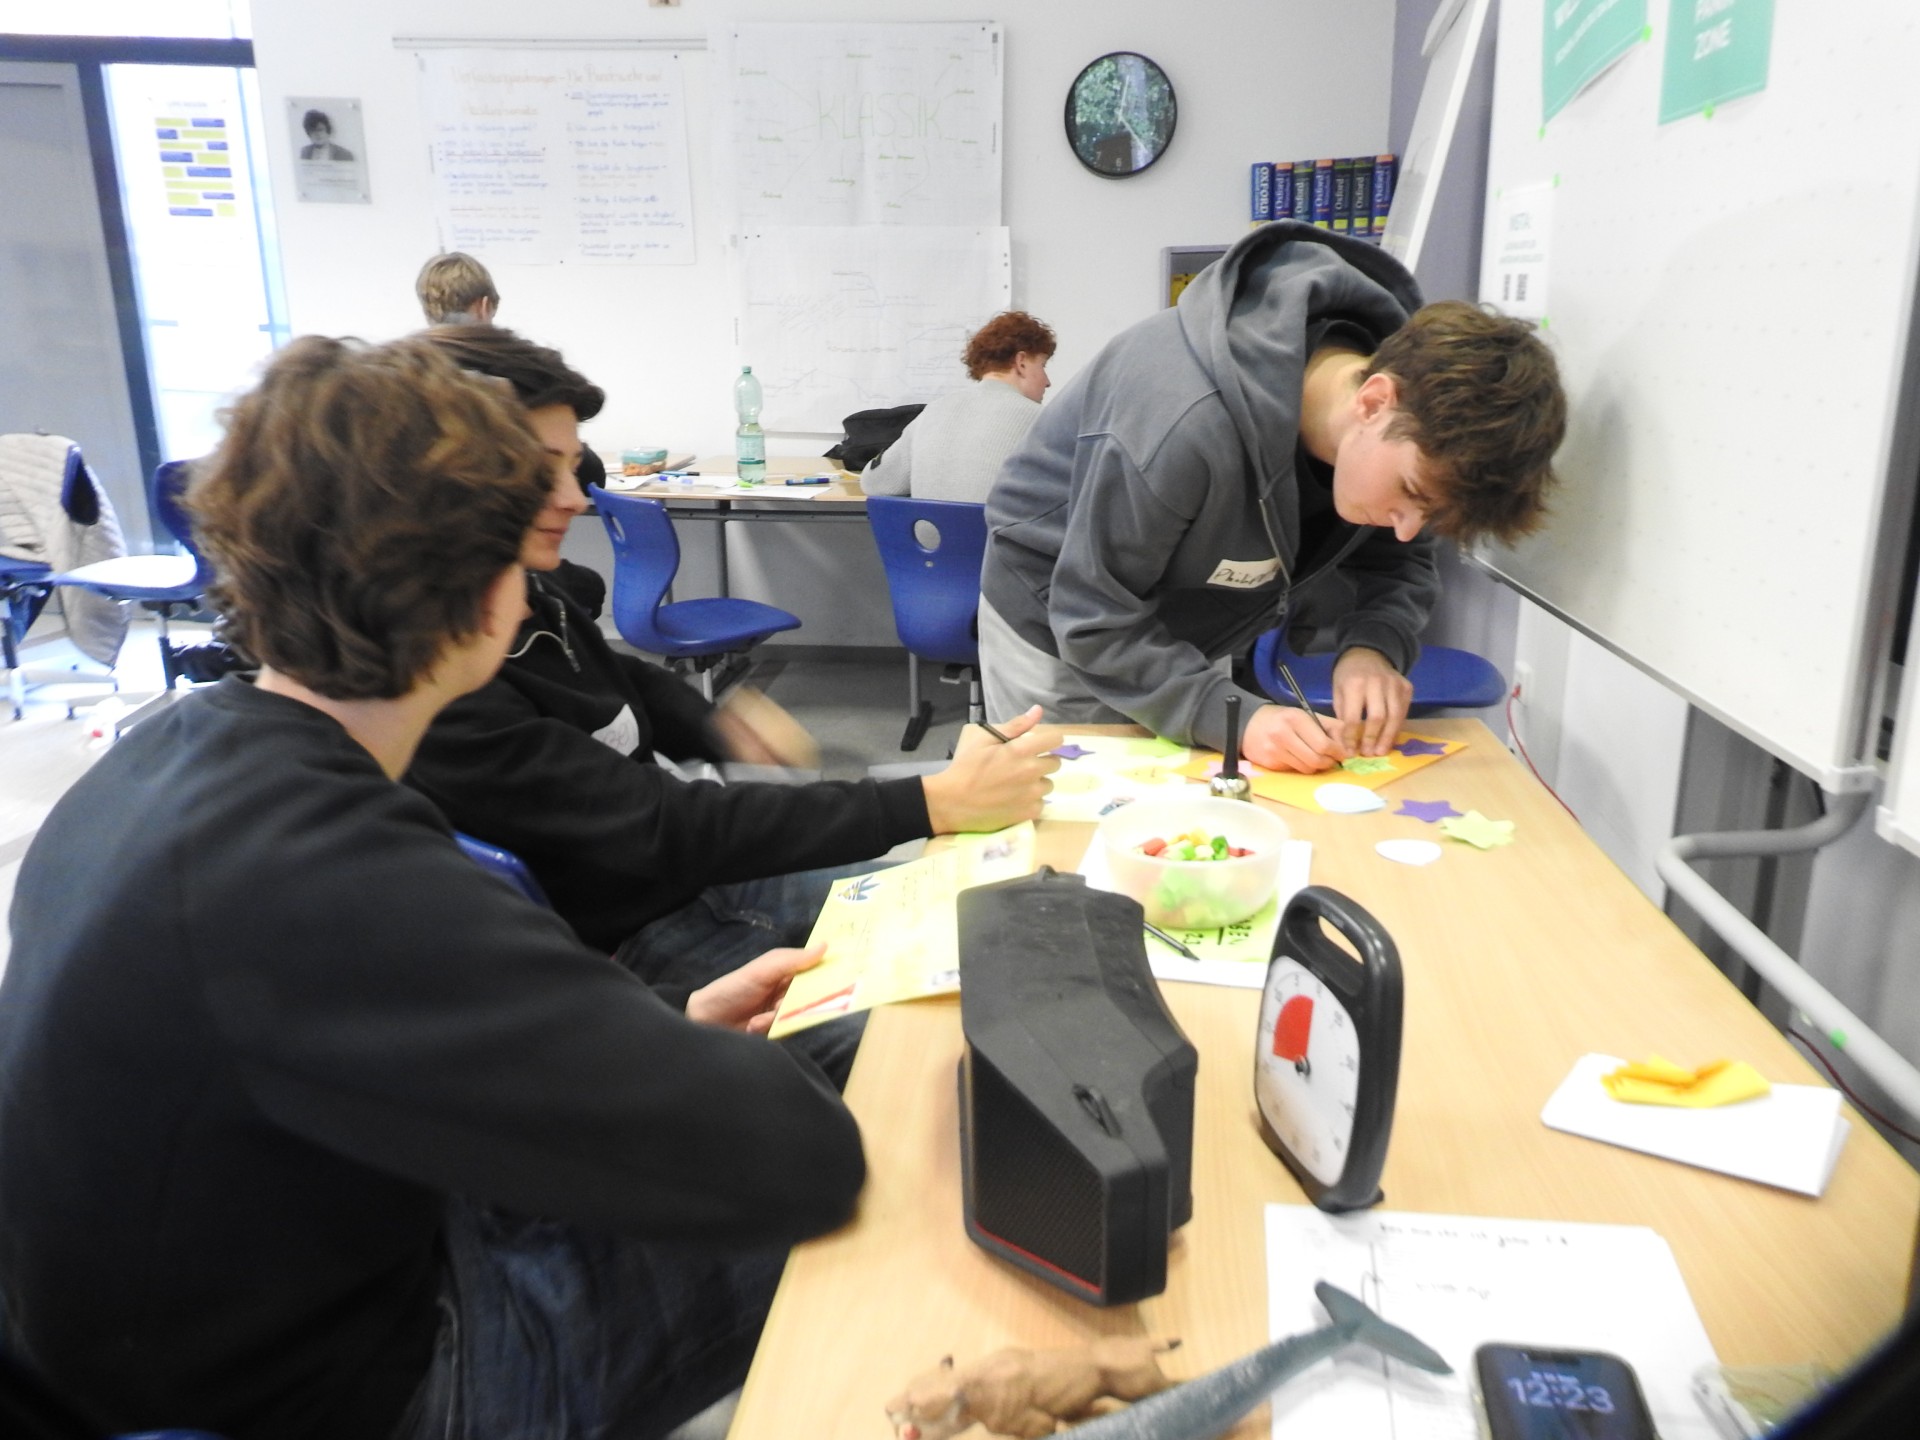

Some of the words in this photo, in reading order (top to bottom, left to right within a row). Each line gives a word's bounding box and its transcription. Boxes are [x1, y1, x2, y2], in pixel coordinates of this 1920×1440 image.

[816, 89, 942, 141] KLASSIK
[1259, 166, 1270, 214] OXFORD
[1275, 177, 1285, 210] Oxford
[1294, 182, 1305, 214] Oxford
[1315, 174, 1324, 207] Oxford
[1335, 178, 1345, 210] Oxford
[1355, 176, 1365, 209] Oxford
[1374, 170, 1385, 203] Oxford
[1505, 1377, 1616, 1414] 12:23
